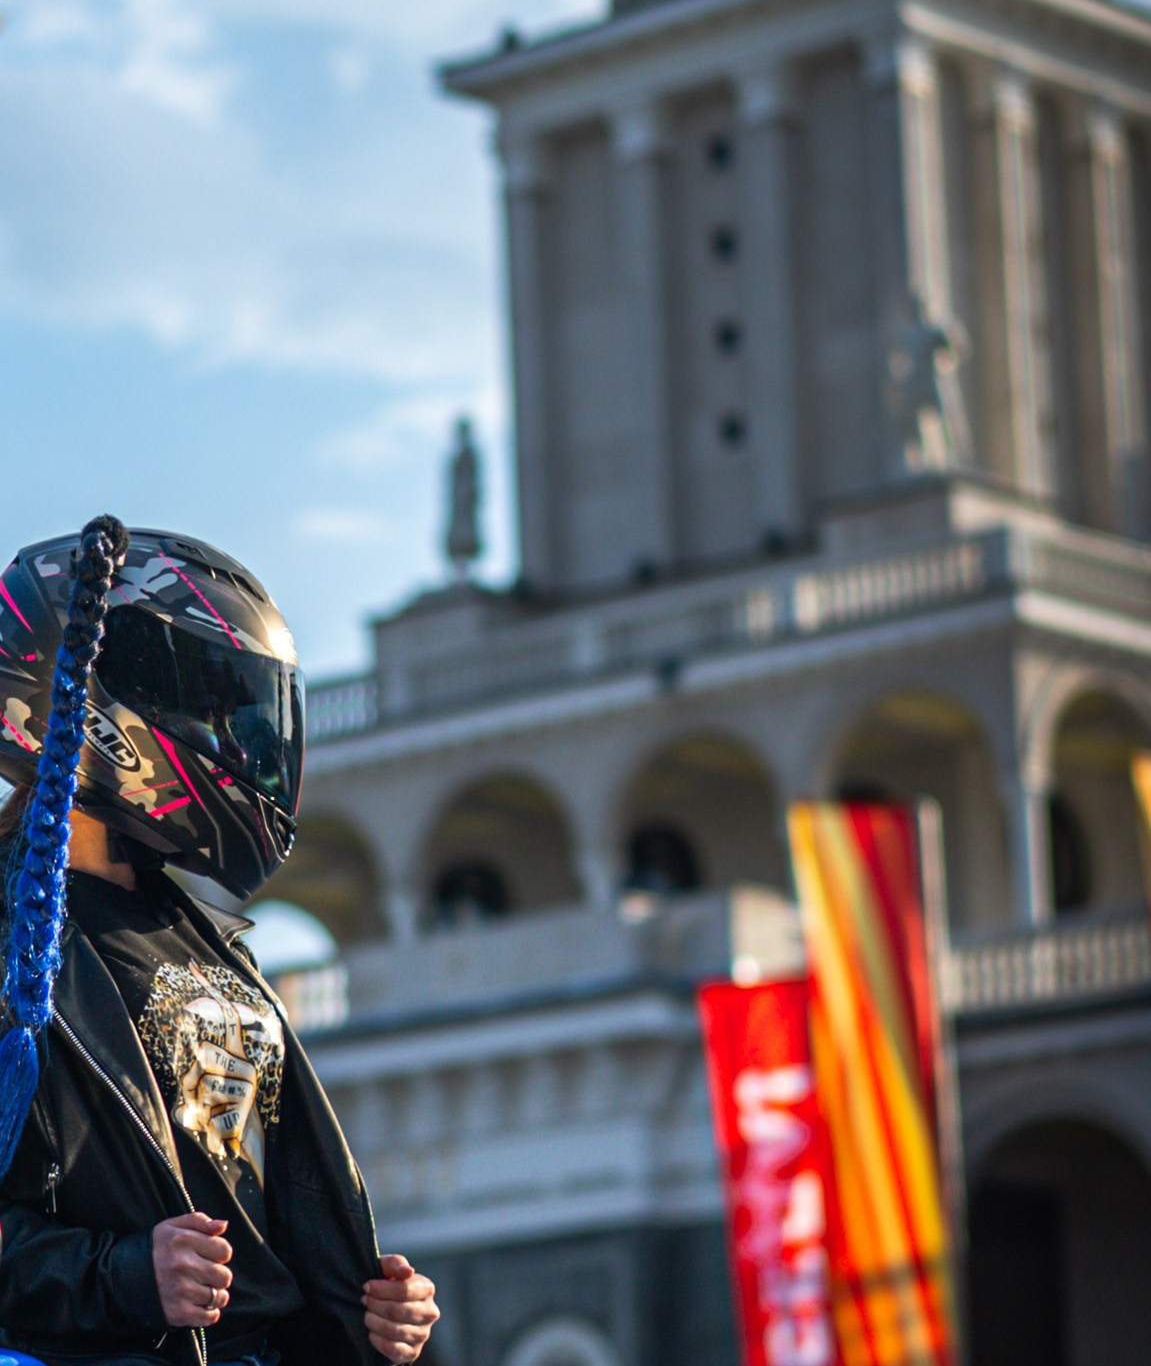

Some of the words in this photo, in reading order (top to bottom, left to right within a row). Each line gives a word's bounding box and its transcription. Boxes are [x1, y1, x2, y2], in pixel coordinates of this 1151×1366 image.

[85, 708, 136, 762] HJC
[215, 1051, 236, 1073] THE
[223, 1111, 240, 1131] UP
